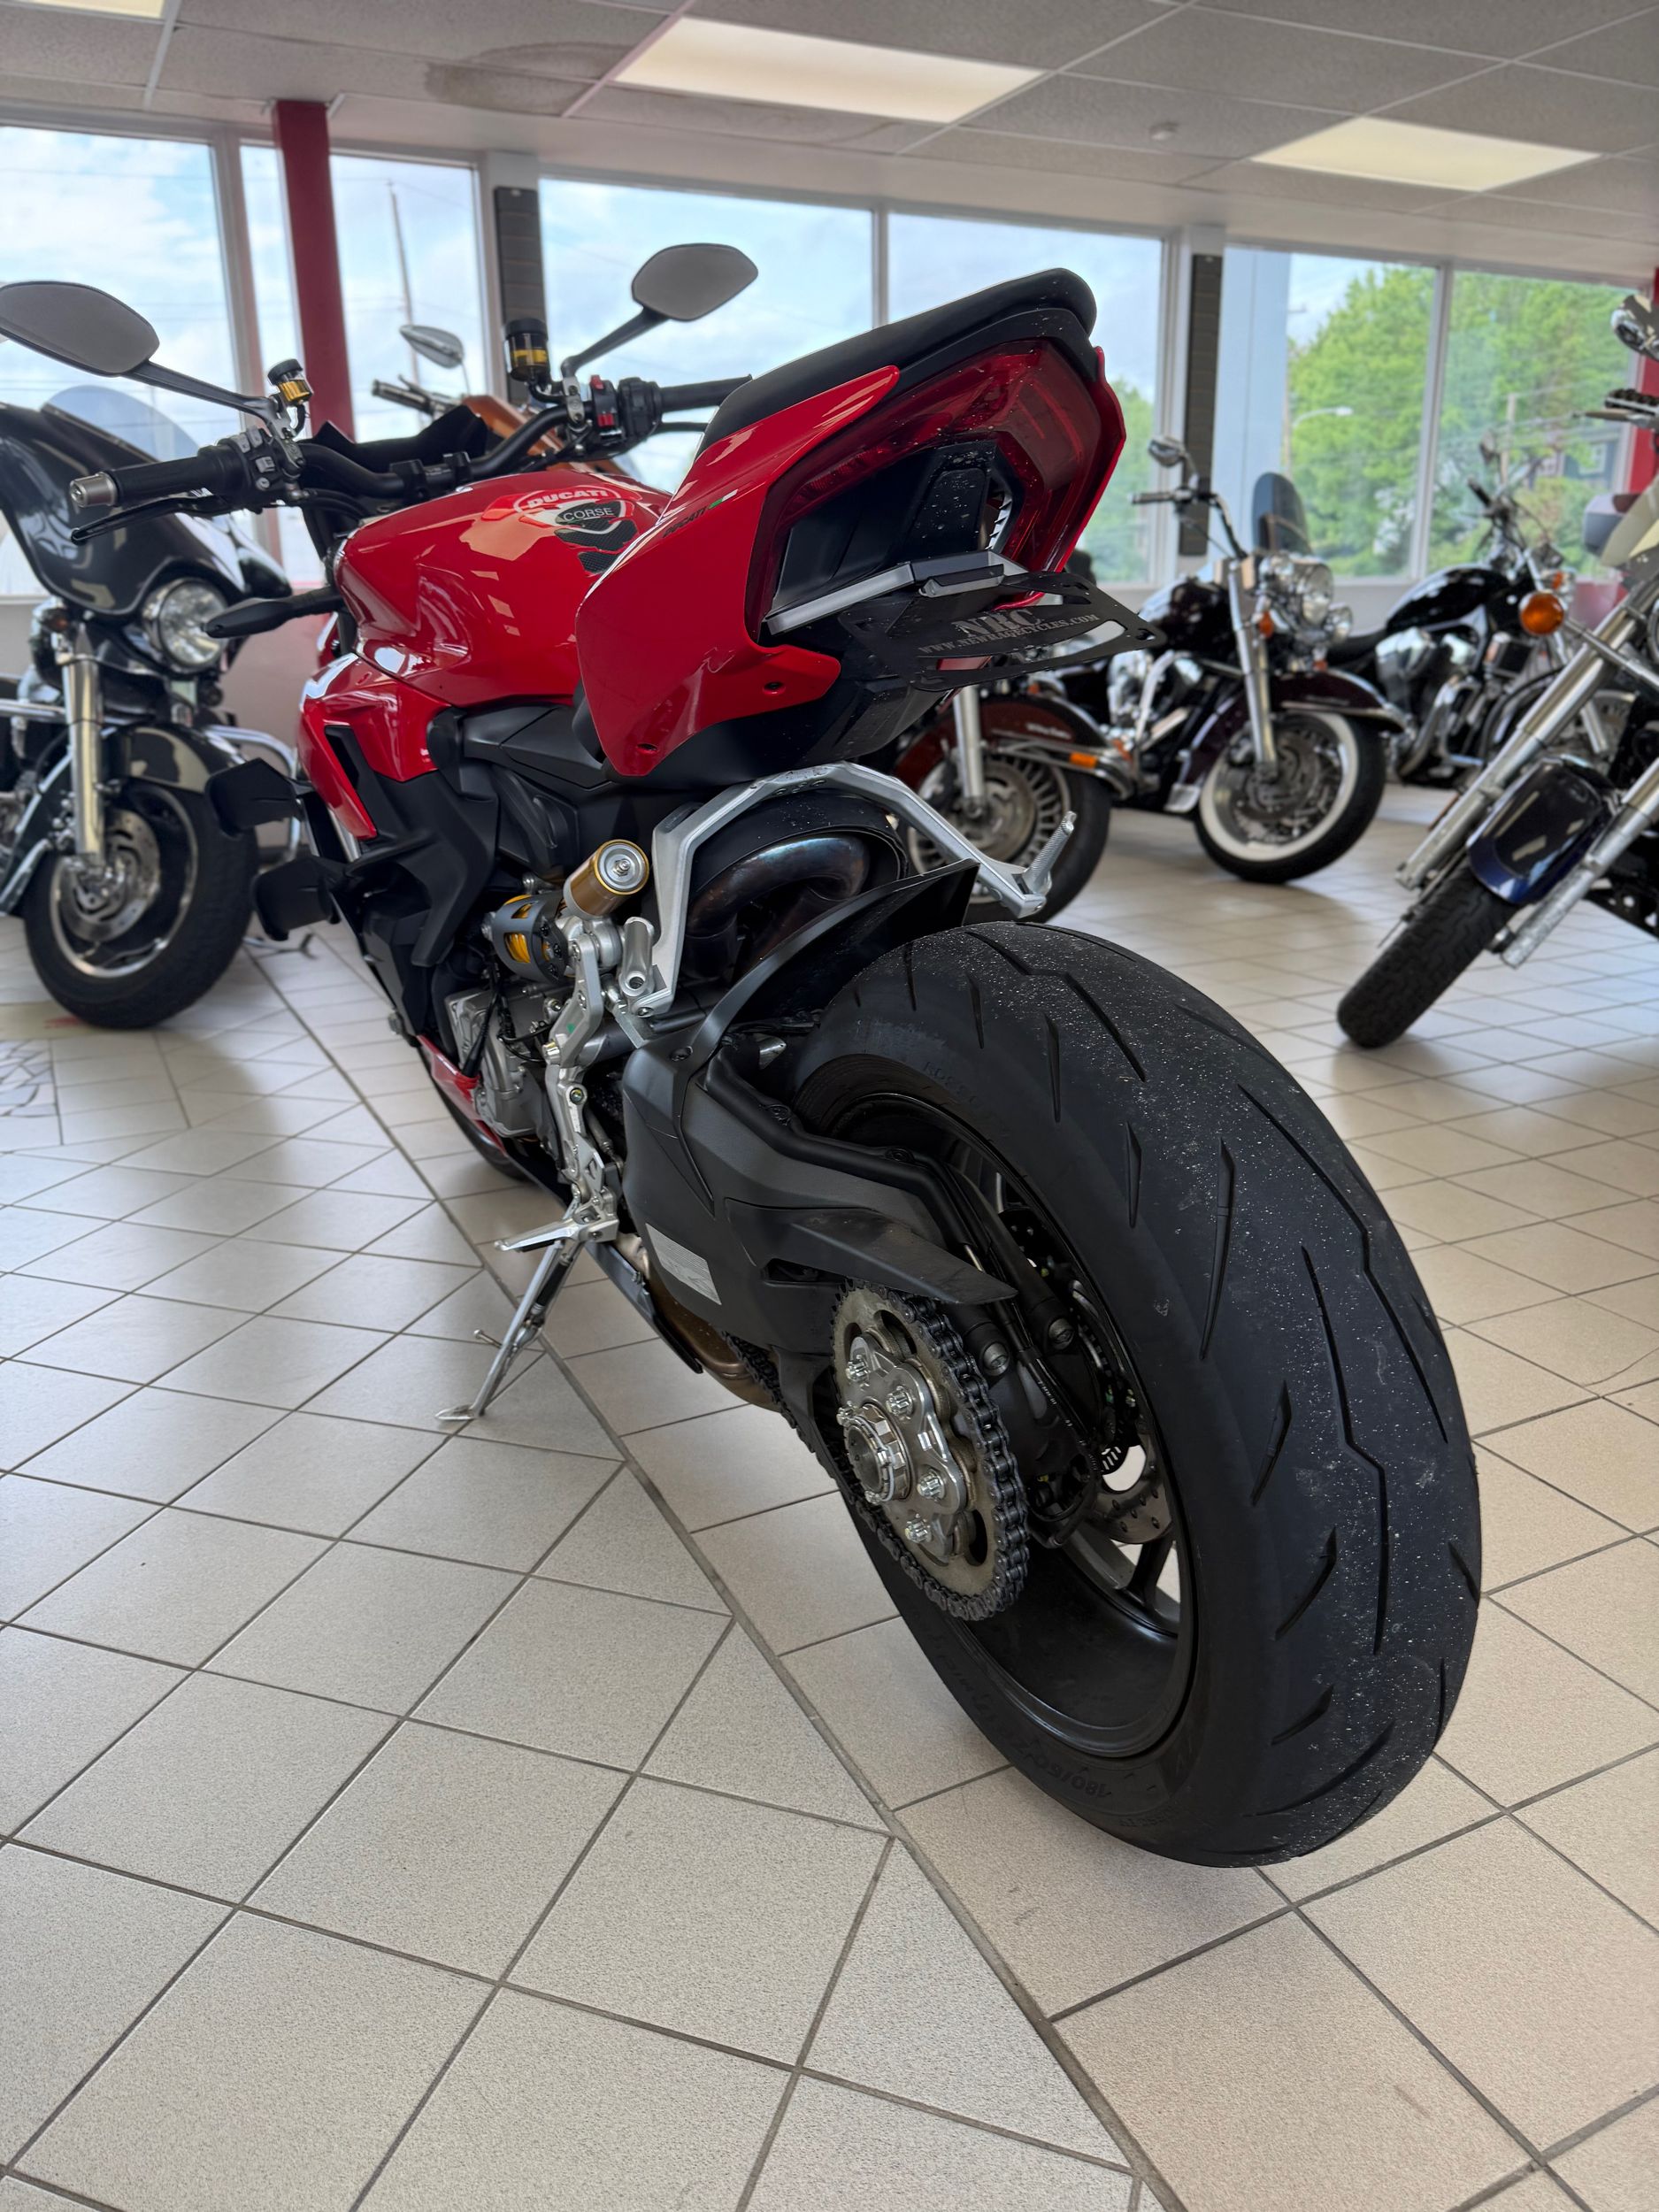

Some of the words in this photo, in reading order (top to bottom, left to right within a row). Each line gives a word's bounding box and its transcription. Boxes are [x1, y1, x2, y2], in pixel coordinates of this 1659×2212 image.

[527, 489, 610, 507] DUCATI
[563, 507, 614, 522] CORSE
[951, 609, 1044, 637] NRC
